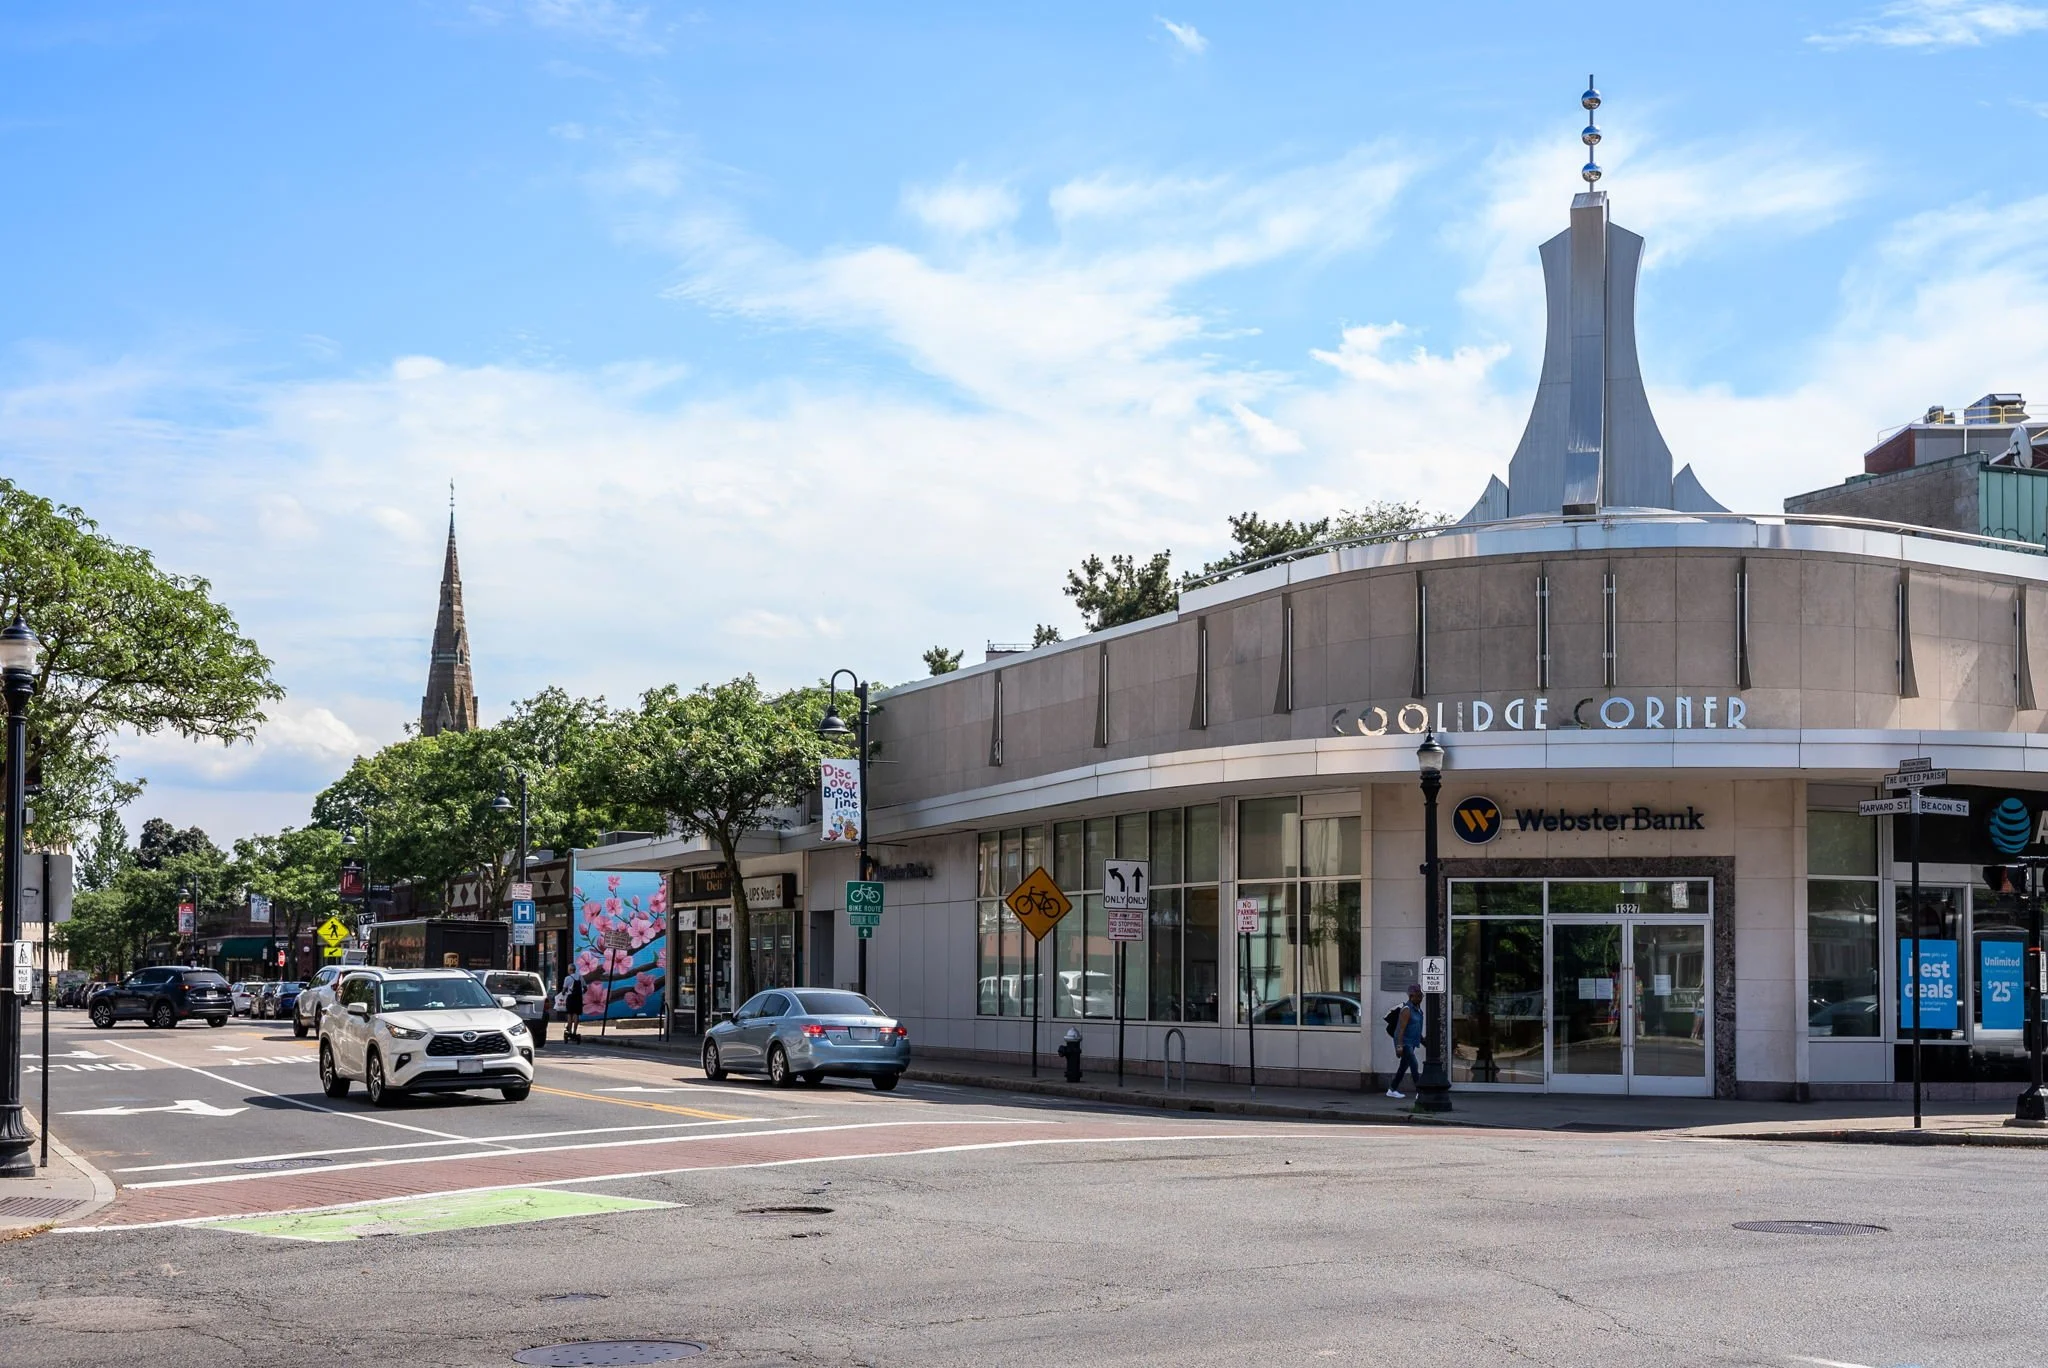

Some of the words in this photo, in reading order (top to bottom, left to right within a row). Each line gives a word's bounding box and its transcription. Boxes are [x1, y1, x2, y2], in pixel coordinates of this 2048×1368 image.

[1331, 697, 1548, 736] COOLIDGE
[1574, 696, 1747, 730] CORNER
[822, 764, 852, 779] Disc
[1886, 776, 1897, 785] THE
[1899, 773, 1921, 783] UNITED
[1923, 771, 1946, 781] PARISH
[830, 779, 858, 790] over
[823, 786, 857, 799] Brook
[835, 797, 858, 809] line
[1860, 803, 1894, 813] HARVARD
[1921, 801, 1952, 812] BEACON
[706, 880, 723, 892] Deli
[749, 887, 760, 901] UPS
[761, 884, 775, 900] Store
[1105, 895, 1126, 904] ONLY
[1128, 896, 1147, 905] ONLY
[1242, 901, 1252, 909] NO
[517, 905, 530, 920] H
[848, 904, 862, 912] BIKE
[864, 905, 882, 913] ROUTE
[1237, 908, 1258, 916] PARKING
[1616, 904, 1640, 914] 1327
[1984, 956, 2020, 967] Unlimited
[1987, 980, 2012, 1002] $25
